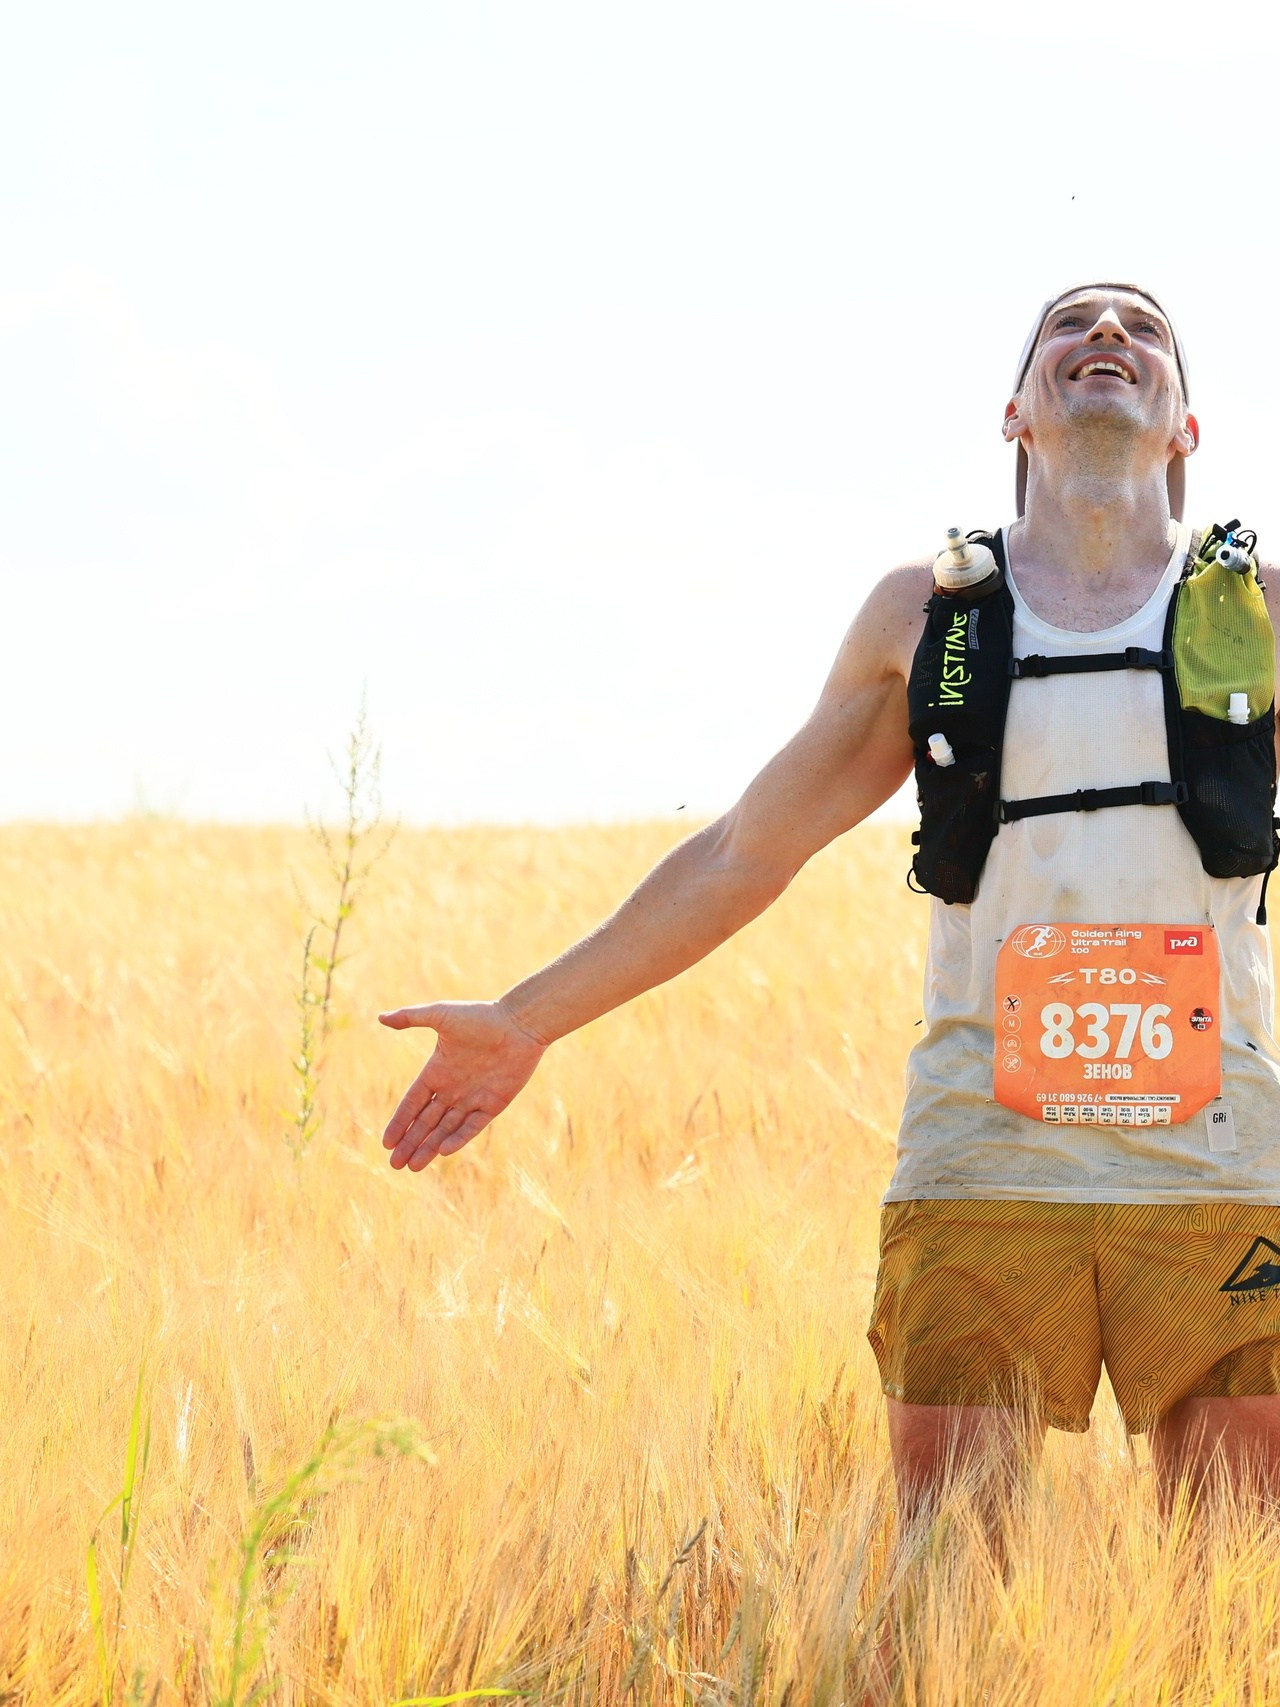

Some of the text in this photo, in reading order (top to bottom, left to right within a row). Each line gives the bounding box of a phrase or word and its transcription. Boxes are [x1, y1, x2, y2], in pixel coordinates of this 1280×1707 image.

[1071, 929, 1142, 939] Golden Ring
[1079, 968, 1137, 985] T80
[1039, 1002, 1174, 1060] 8376
[1083, 1063, 1132, 1080] ЗЕНОВ
[1036, 1093, 1047, 1102] 69
[1048, 1094, 1058, 1102] 31
[1059, 1094, 1076, 1102] 680
[1077, 1094, 1093, 1102] 926
[1212, 1112, 1227, 1124] GRi
[1230, 1290, 1267, 1306] NIKE
